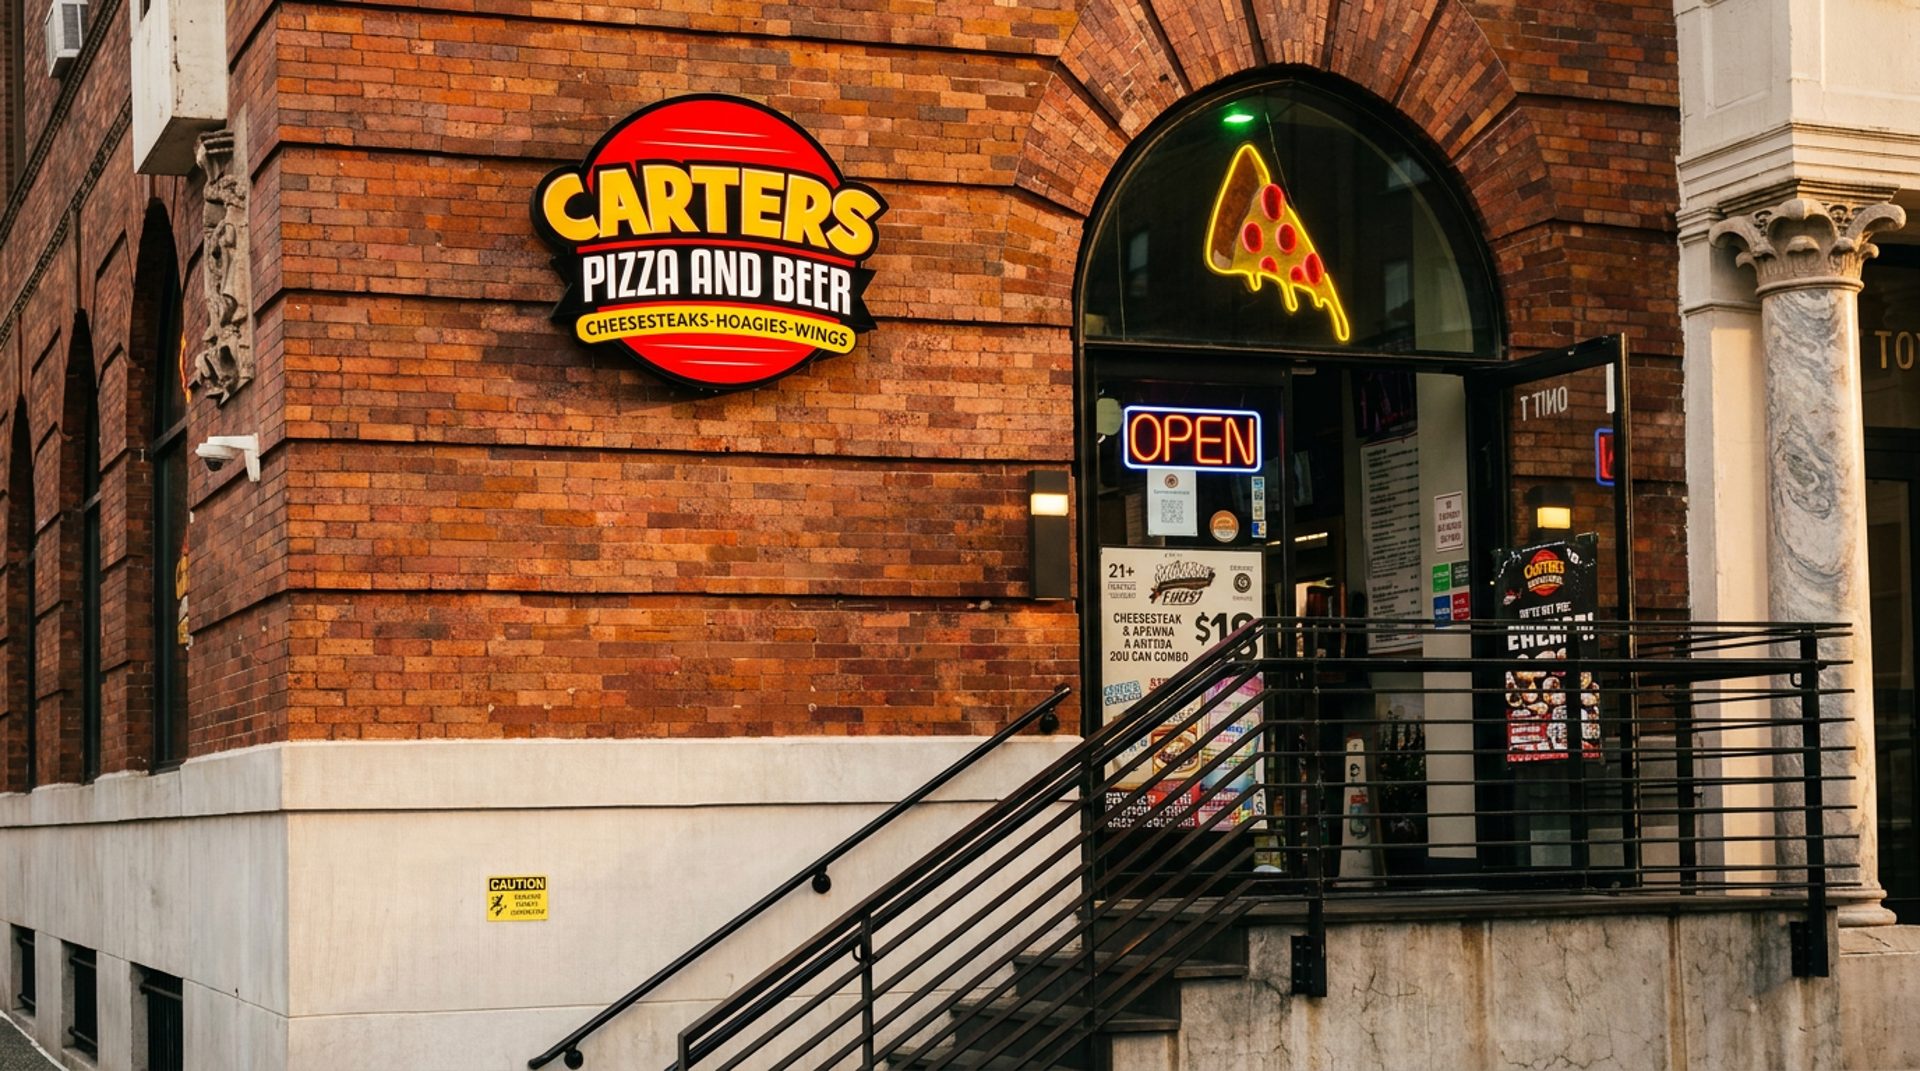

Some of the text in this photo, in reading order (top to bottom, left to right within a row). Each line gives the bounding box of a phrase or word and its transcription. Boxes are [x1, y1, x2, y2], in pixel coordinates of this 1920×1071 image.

[543, 164, 880, 256] CARTERS
[582, 248, 851, 315] PIZZA AND BEER
[1874, 330, 1920, 370] TO
[1130, 413, 1255, 465] OPEN
[1109, 563, 1134, 578] 21+
[1113, 612, 1182, 624] CHEESESTEAK
[1122, 625, 1130, 636] &
[1132, 651, 1151, 662] CAN
[1154, 651, 1189, 662] COMBO
[491, 878, 545, 890] CAUTION
